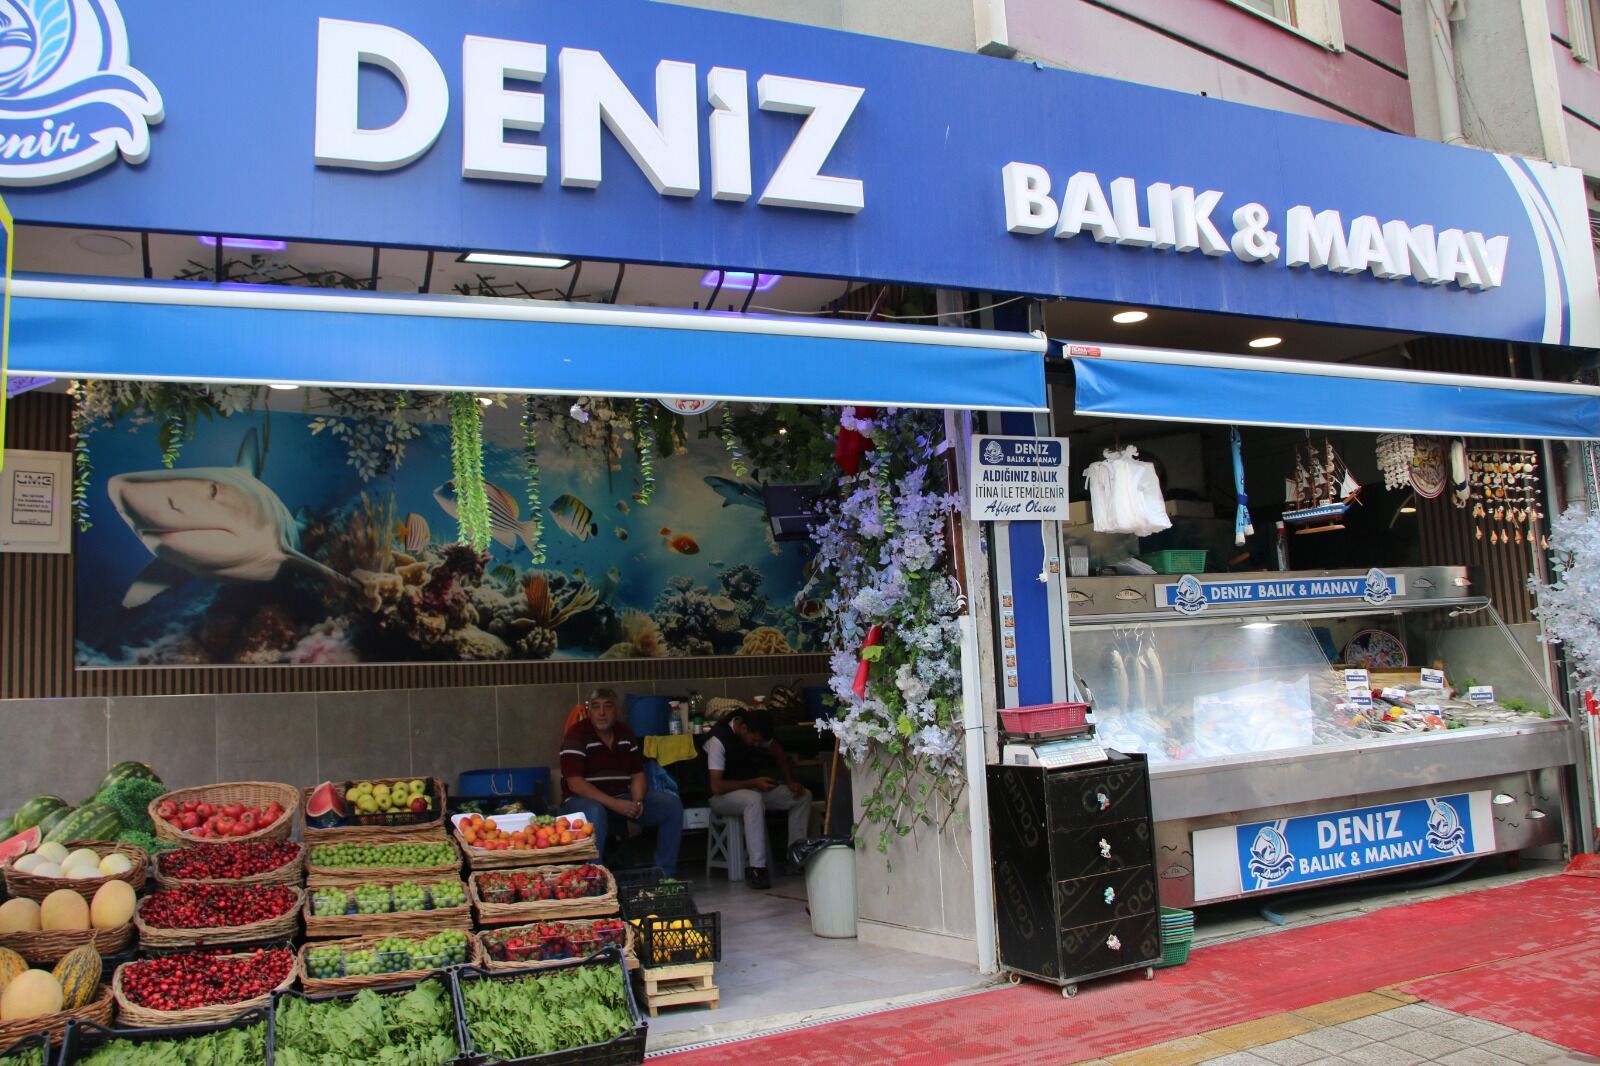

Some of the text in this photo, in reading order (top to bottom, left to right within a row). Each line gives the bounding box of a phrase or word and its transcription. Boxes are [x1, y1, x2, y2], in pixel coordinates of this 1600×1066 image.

[1002, 161, 1509, 291] BALIK & MANAV
[1006, 455, 1025, 463] BALIK
[983, 467, 1058, 483] ALDIĞINIZ BALIK
[984, 499, 1022, 517] Afiyet
[1258, 583, 1295, 598] BALIK
[1299, 584, 1306, 596] &
[1310, 581, 1359, 595] MANAV
[1299, 840, 1424, 875] BALIK & MANAV
